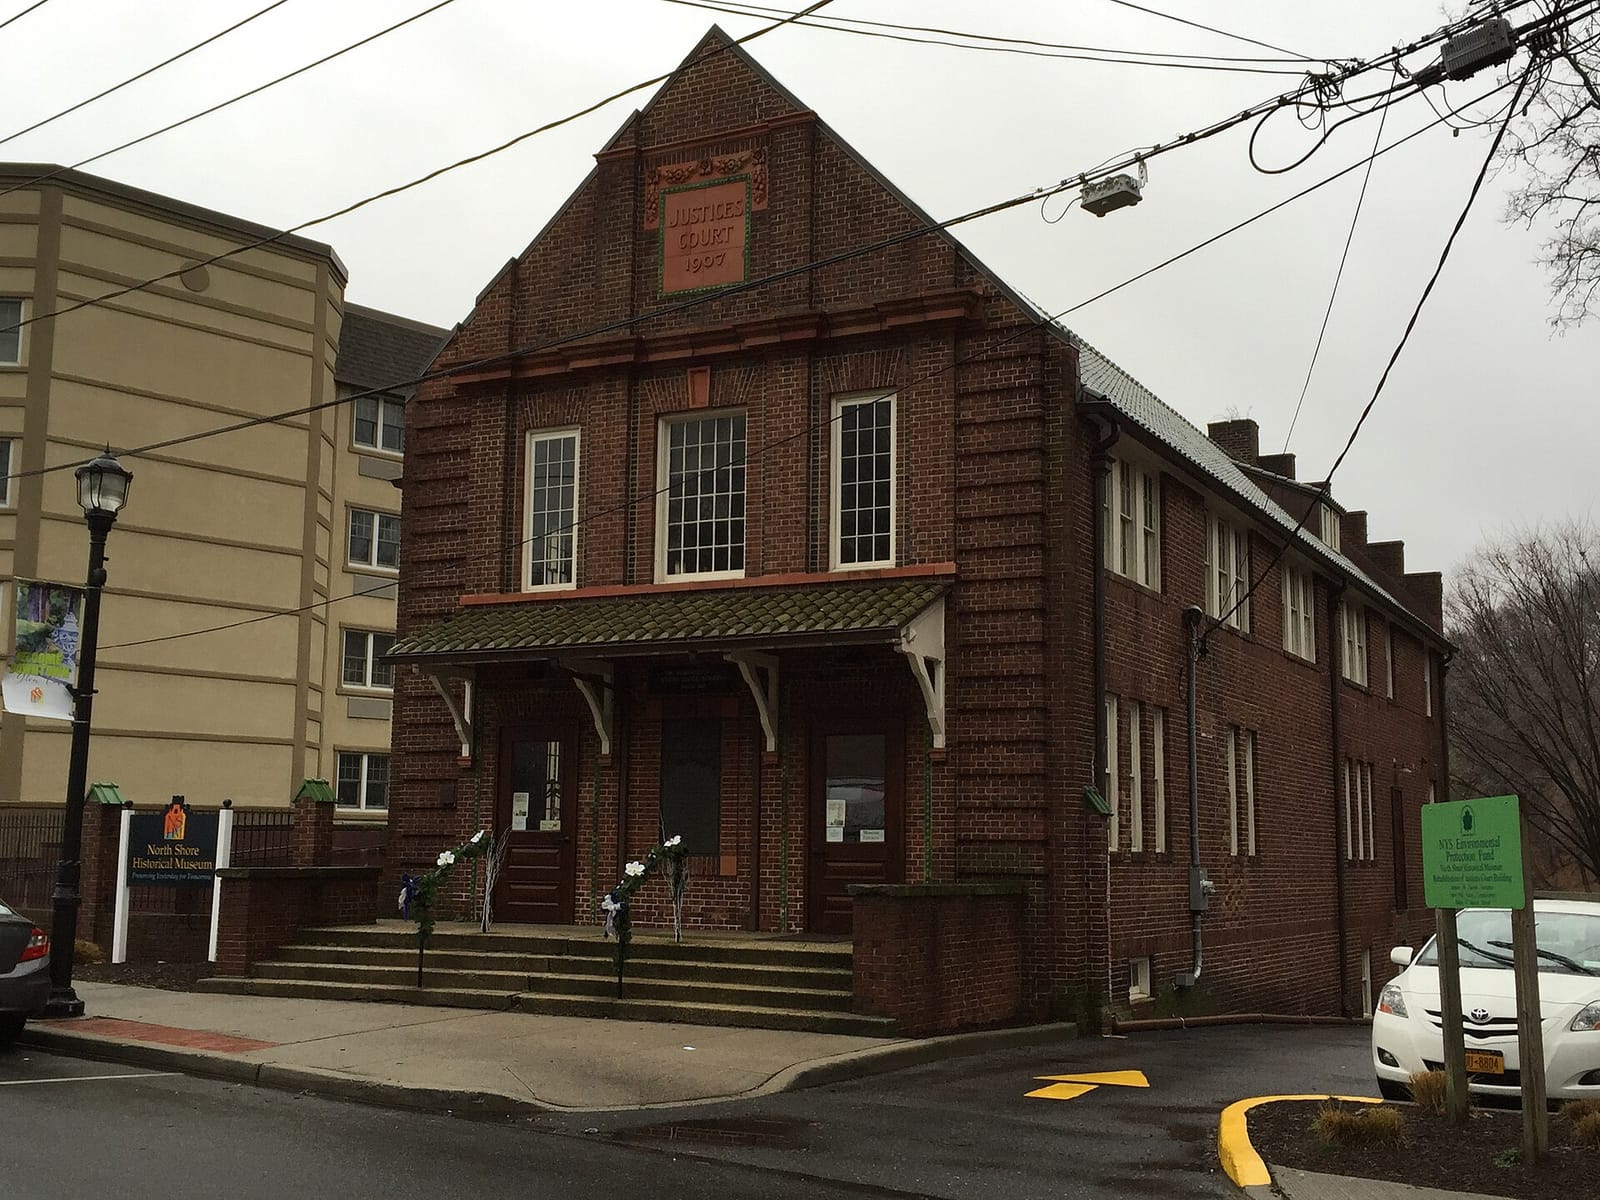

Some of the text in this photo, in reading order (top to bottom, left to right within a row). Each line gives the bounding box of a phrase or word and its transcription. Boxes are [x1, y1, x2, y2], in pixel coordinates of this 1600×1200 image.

[670, 200, 745, 228] JUSTICES
[680, 226, 734, 249] COURT
[686, 252, 726, 273] 1907
[147, 843, 200, 856] North Shore
[1456, 836, 1501, 849] Environmental
[132, 857, 213, 870] Historical Museum
